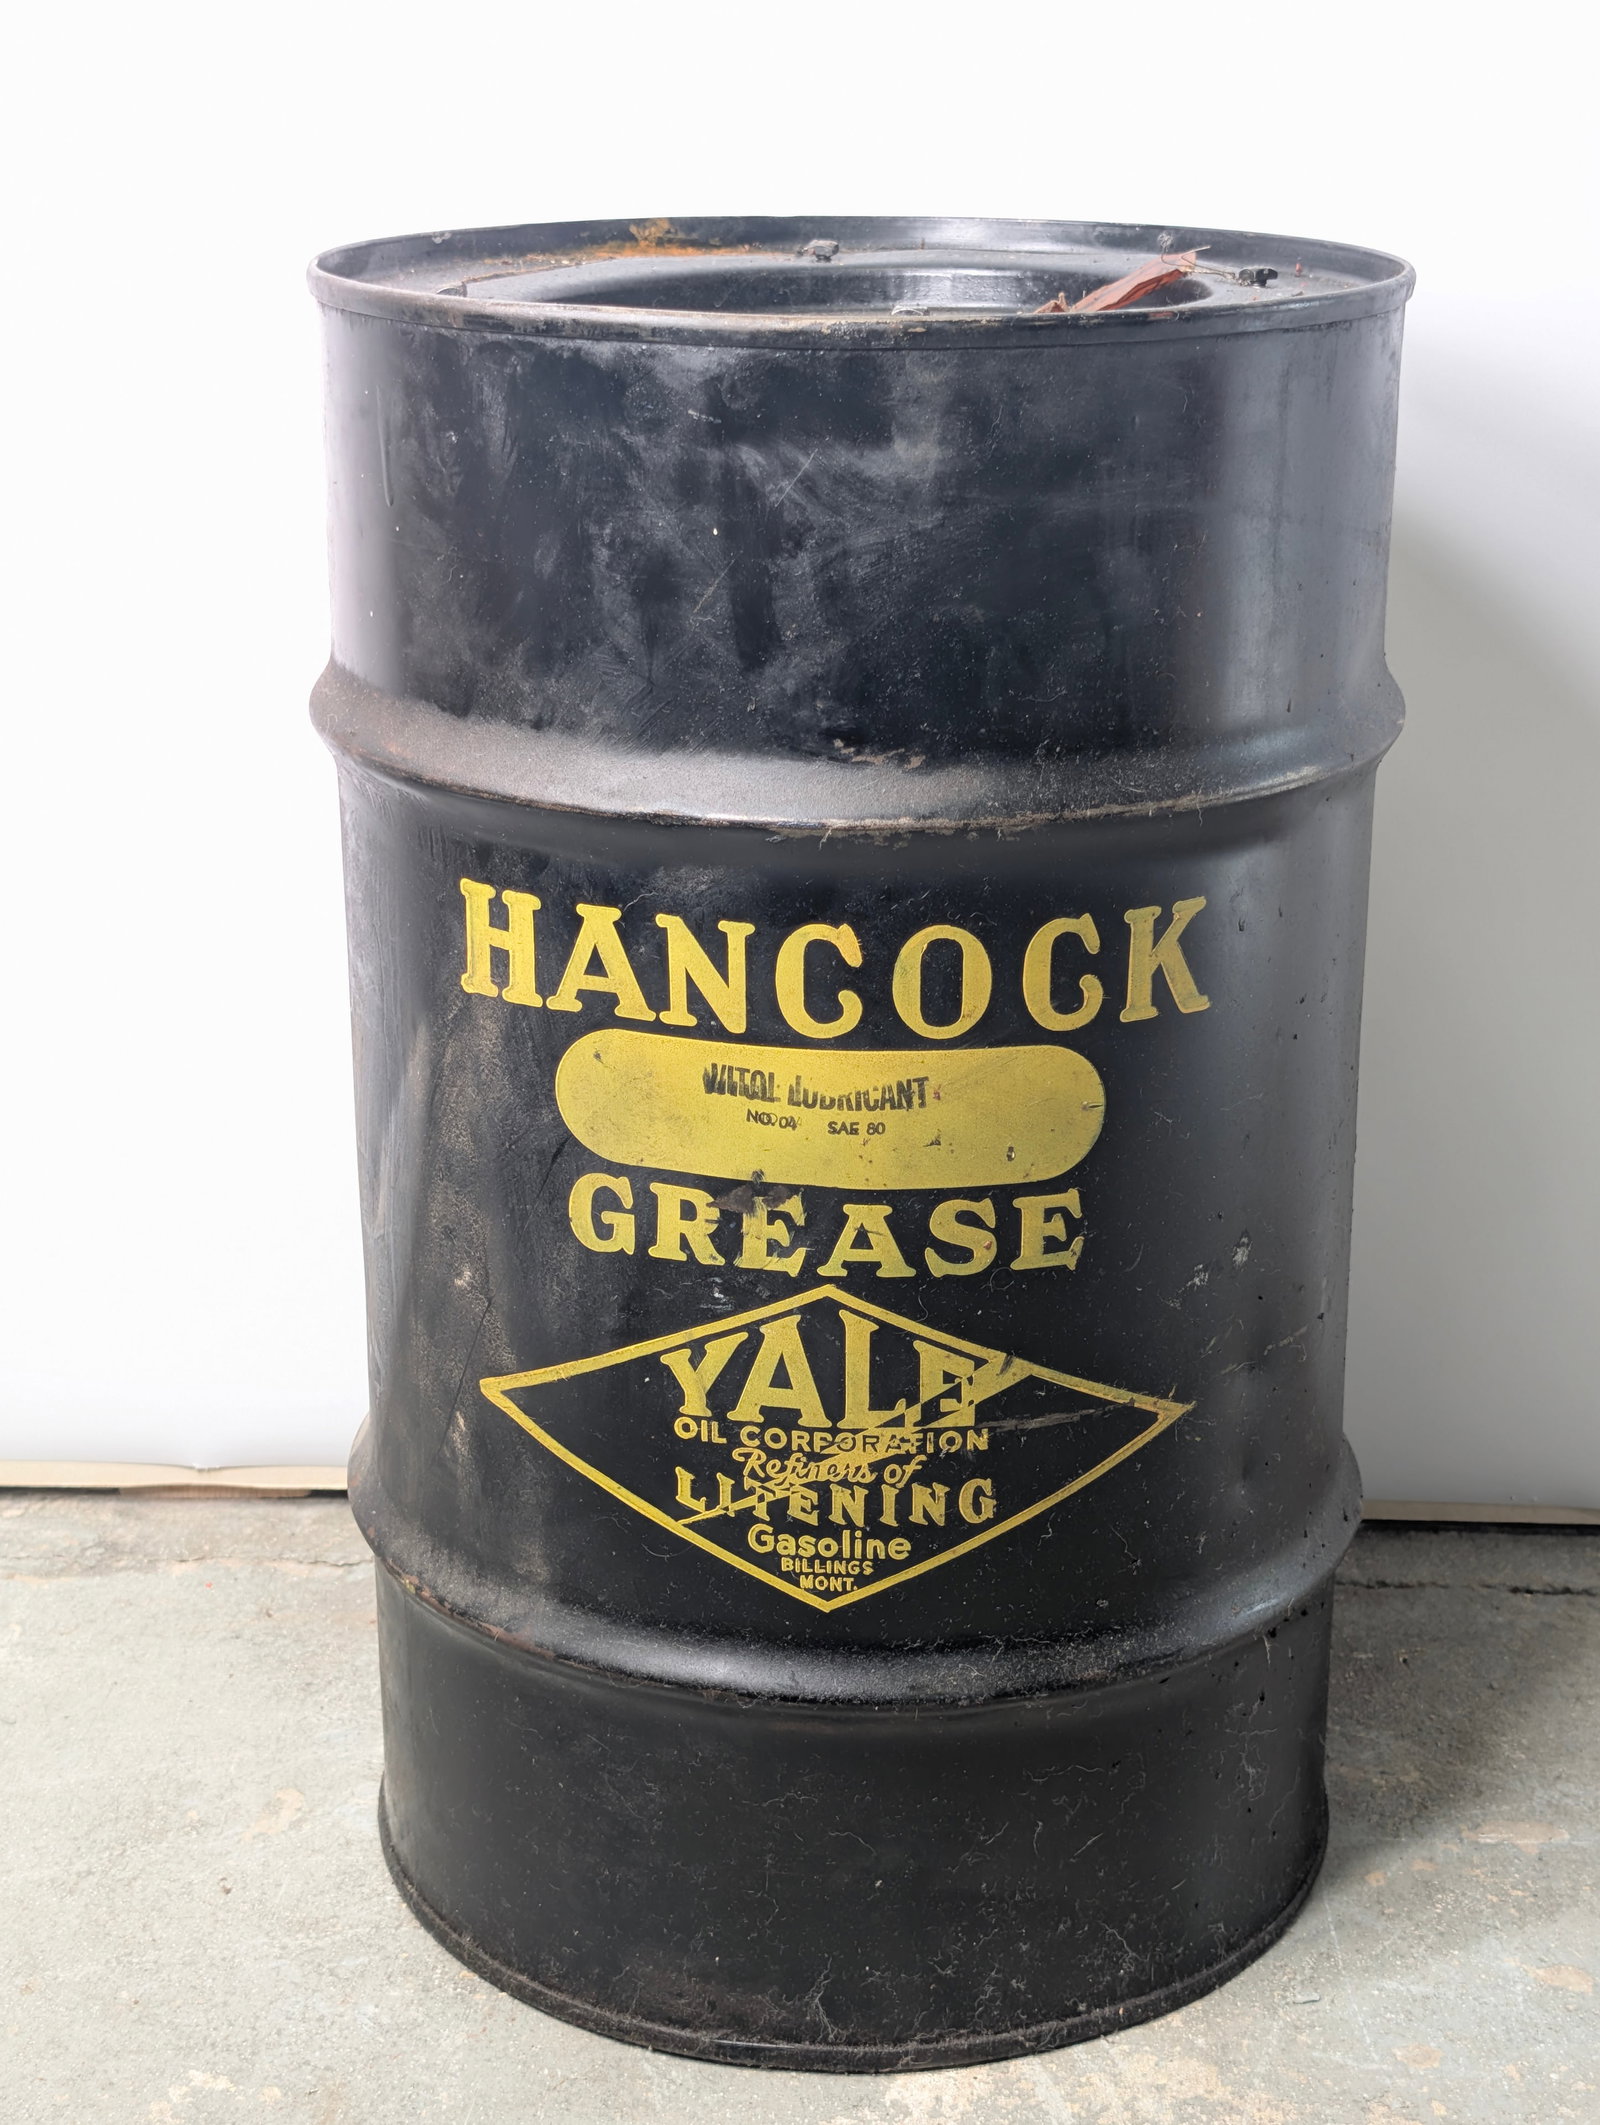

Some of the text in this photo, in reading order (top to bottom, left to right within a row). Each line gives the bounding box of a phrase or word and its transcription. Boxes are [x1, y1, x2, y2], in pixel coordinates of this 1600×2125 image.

[460, 878, 1209, 1040] HANCOCK
[828, 1120, 860, 1136] SAE
[867, 1121, 886, 1136] 80
[569, 1173, 1085, 1278] GREASE
[660, 1309, 976, 1428] YALE
[673, 1416, 989, 1453] OIL CORPORATION
[732, 1448, 926, 1490] Refiners of
[675, 1466, 997, 1527] LITENING
[747, 1523, 912, 1560] Gasoline
[780, 1557, 874, 1576] BILLINGS
[799, 1575, 858, 1592] MONT.
